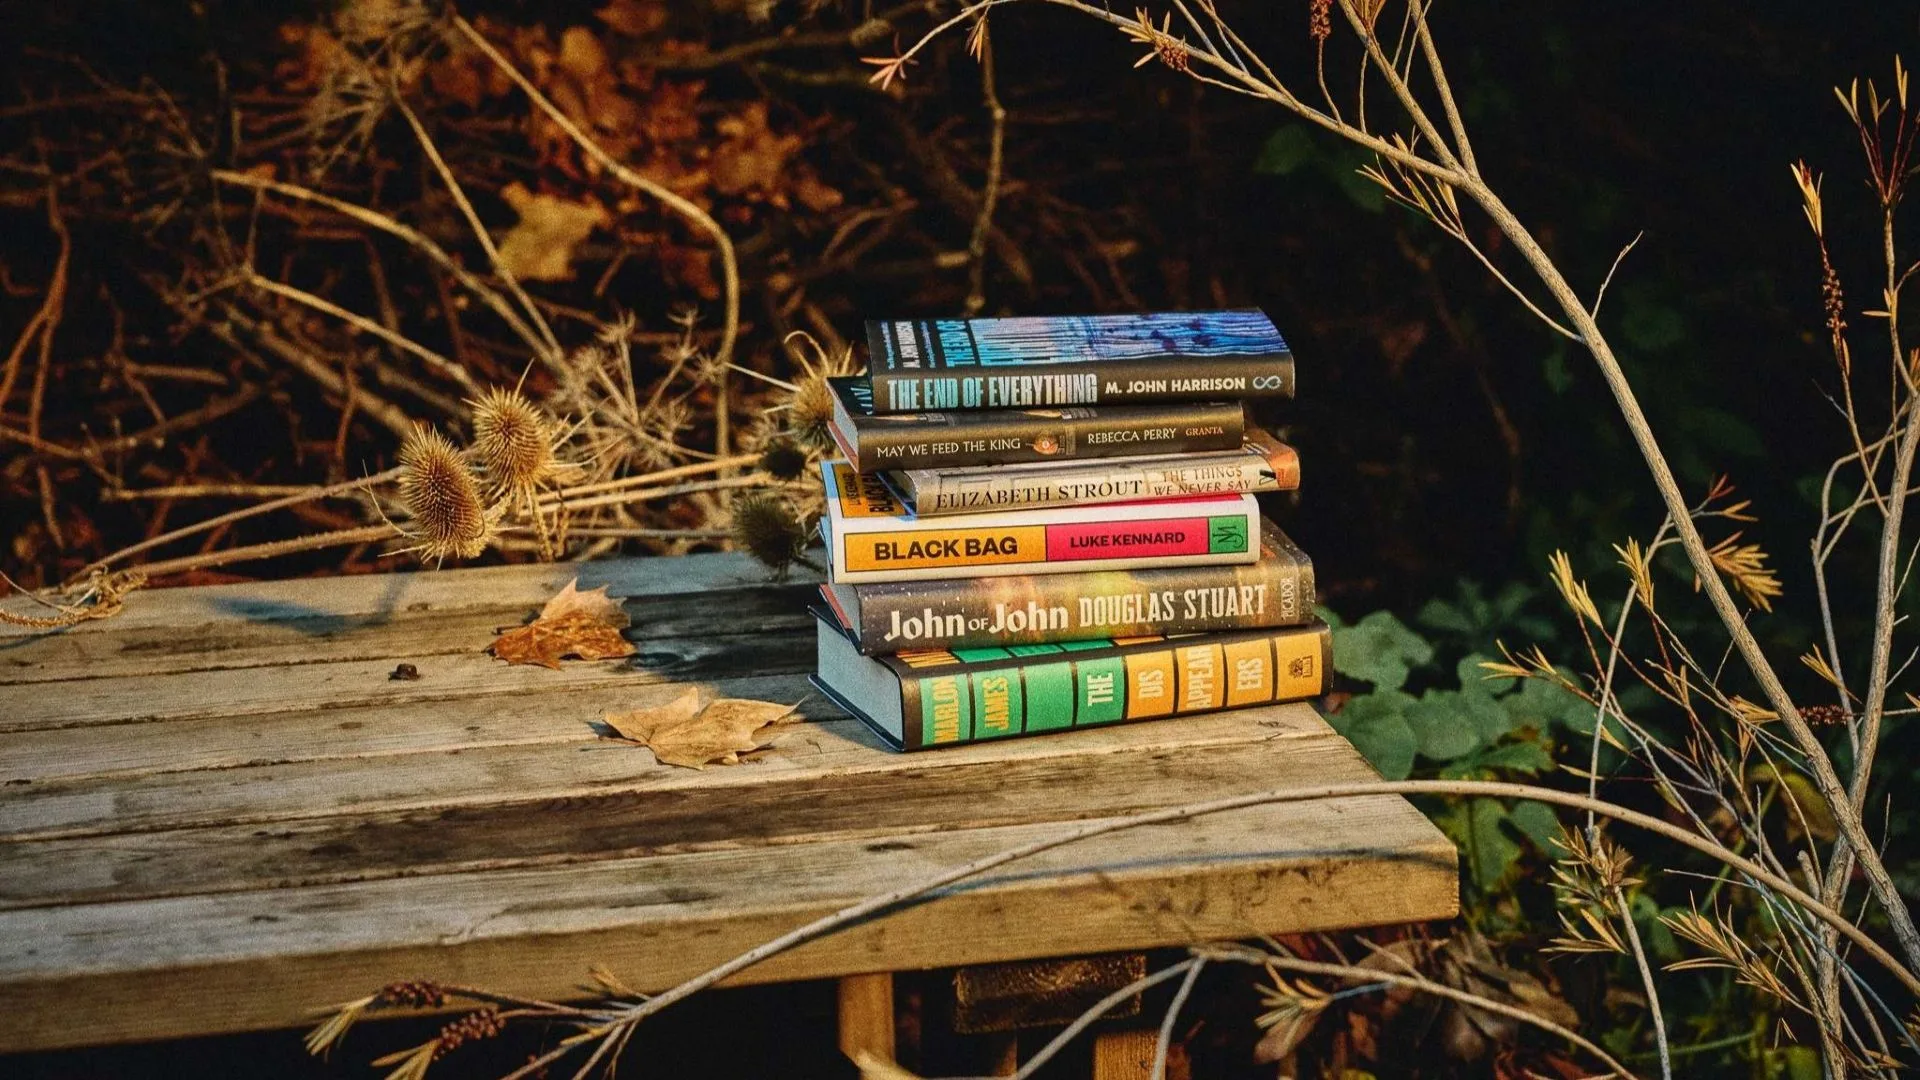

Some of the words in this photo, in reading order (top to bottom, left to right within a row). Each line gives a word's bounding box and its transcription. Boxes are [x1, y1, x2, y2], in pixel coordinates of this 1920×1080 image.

[939, 332, 971, 348] END
[942, 349, 976, 368] THE
[887, 379, 920, 410] THE
[924, 378, 959, 409] END
[962, 377, 984, 408] OF
[988, 373, 1098, 406] EVERYTHING
[1105, 381, 1122, 394] M.
[1126, 379, 1167, 394] JOHN
[1171, 377, 1246, 392] HARRISON
[1087, 430, 1140, 444] REBECCA
[1144, 428, 1177, 442] PERRY
[1185, 426, 1223, 437] GRANTA
[877, 445, 905, 458] MAY
[909, 443, 928, 455] WE
[932, 442, 959, 455] FEED
[963, 440, 985, 453] THE
[990, 438, 1021, 451] KING
[1162, 468, 1188, 483] THE
[1194, 465, 1243, 480] THINGS
[936, 486, 1050, 509] ELIZABETH
[1058, 481, 1143, 500] STROUT
[1154, 485, 1173, 496] WE
[1178, 481, 1221, 495] NEVER
[1228, 479, 1251, 491] SAY
[874, 538, 961, 561] BLACK
[965, 536, 1018, 557] BAG
[1070, 535, 1109, 549] LUKE
[1112, 531, 1185, 546] KENNARD
[1079, 591, 1175, 628] DOUGLAS
[1184, 584, 1267, 621] STUART
[1280, 576, 1296, 619] PICADOR
[884, 607, 965, 642] John
[968, 617, 989, 631] OF
[989, 601, 1069, 634] John
[1087, 671, 1114, 708] THE
[1137, 669, 1165, 699] DIS
[1186, 645, 1214, 709] APPEAR
[1236, 657, 1265, 691] ERS
[932, 676, 960, 744] MARLON
[982, 676, 1009, 730] JAMES
